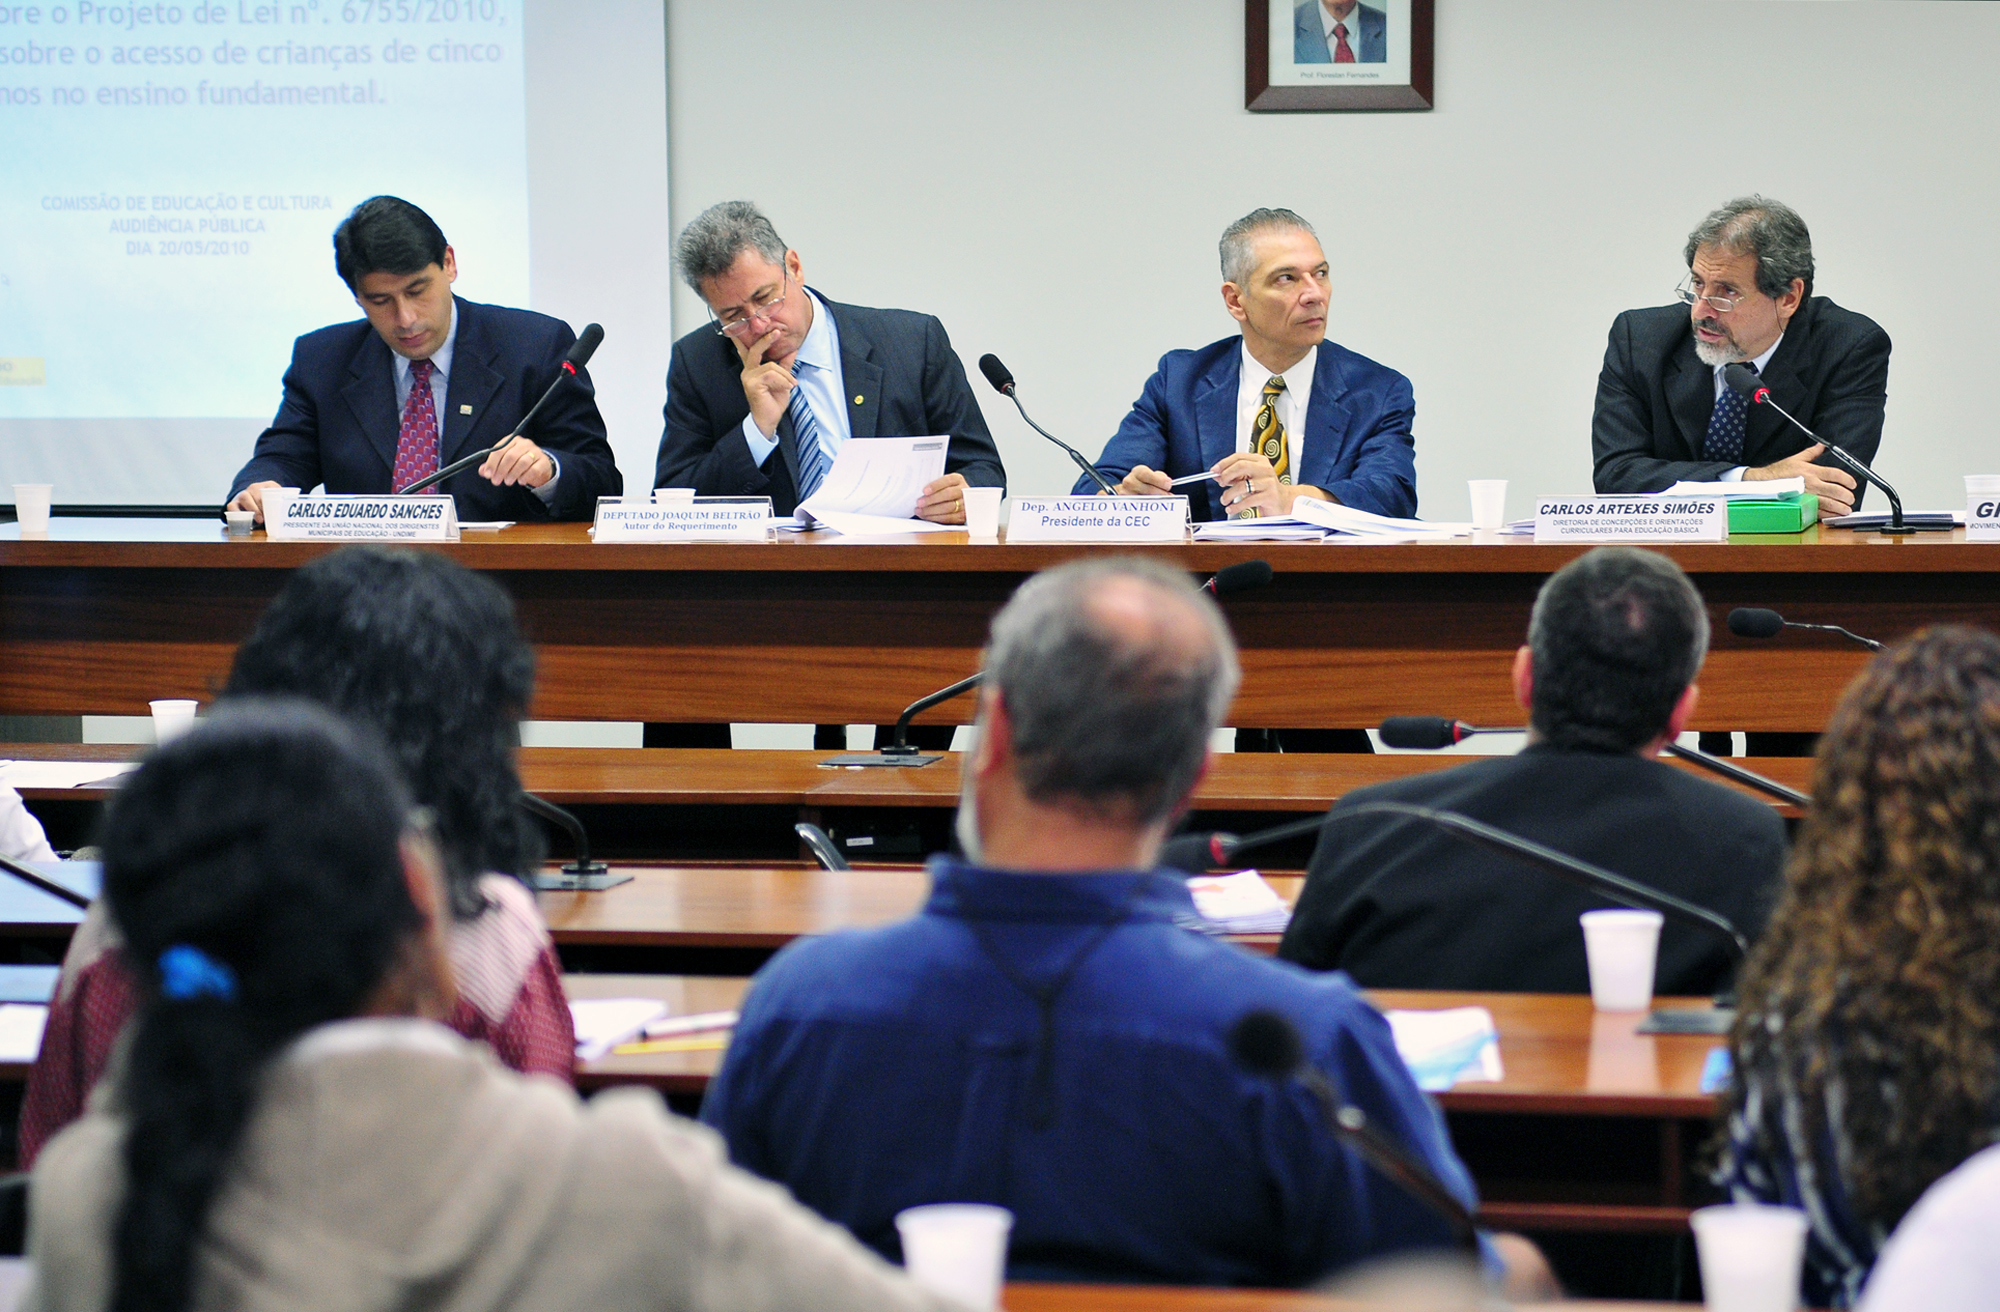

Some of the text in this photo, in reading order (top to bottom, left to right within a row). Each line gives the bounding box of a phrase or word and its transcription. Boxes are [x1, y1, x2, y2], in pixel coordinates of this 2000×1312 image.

[51, 5, 67, 25] o
[79, 0, 182, 31] Projeto
[193, 0, 227, 25] de
[239, 0, 278, 24] Lei
[341, 0, 506, 26] 6755/2010,
[0, 38, 502, 70] sobre o acesso de crianças de cinco
[52, 86, 85, 105] no
[97, 81, 187, 105] ensino
[198, 79, 386, 105] fundamental.
[41, 193, 332, 213] COMISSÃO DE EDUCAÇÃO E CULTURA
[109, 215, 266, 233] AUDIÊNCIA PÚBLICA
[126, 241, 249, 256] DIA 20/05/2010
[288, 503, 443, 518] CARLOS EDUARDO SANCHES
[1021, 502, 1174, 513] Dep. ANGELO VANHONI
[1540, 501, 1715, 515] CARLOS ARTEXES SIMÕES
[603, 510, 760, 521] DEPUTADO JOAQUIM BELTRÃO
[1042, 516, 1150, 527] Presidente da CEC
[623, 522, 737, 531] Autor do Requerimento
[1634, 526, 1673, 535] EDUCAÇÃO
[354, 530, 388, 538] EDUCAÇÃO
